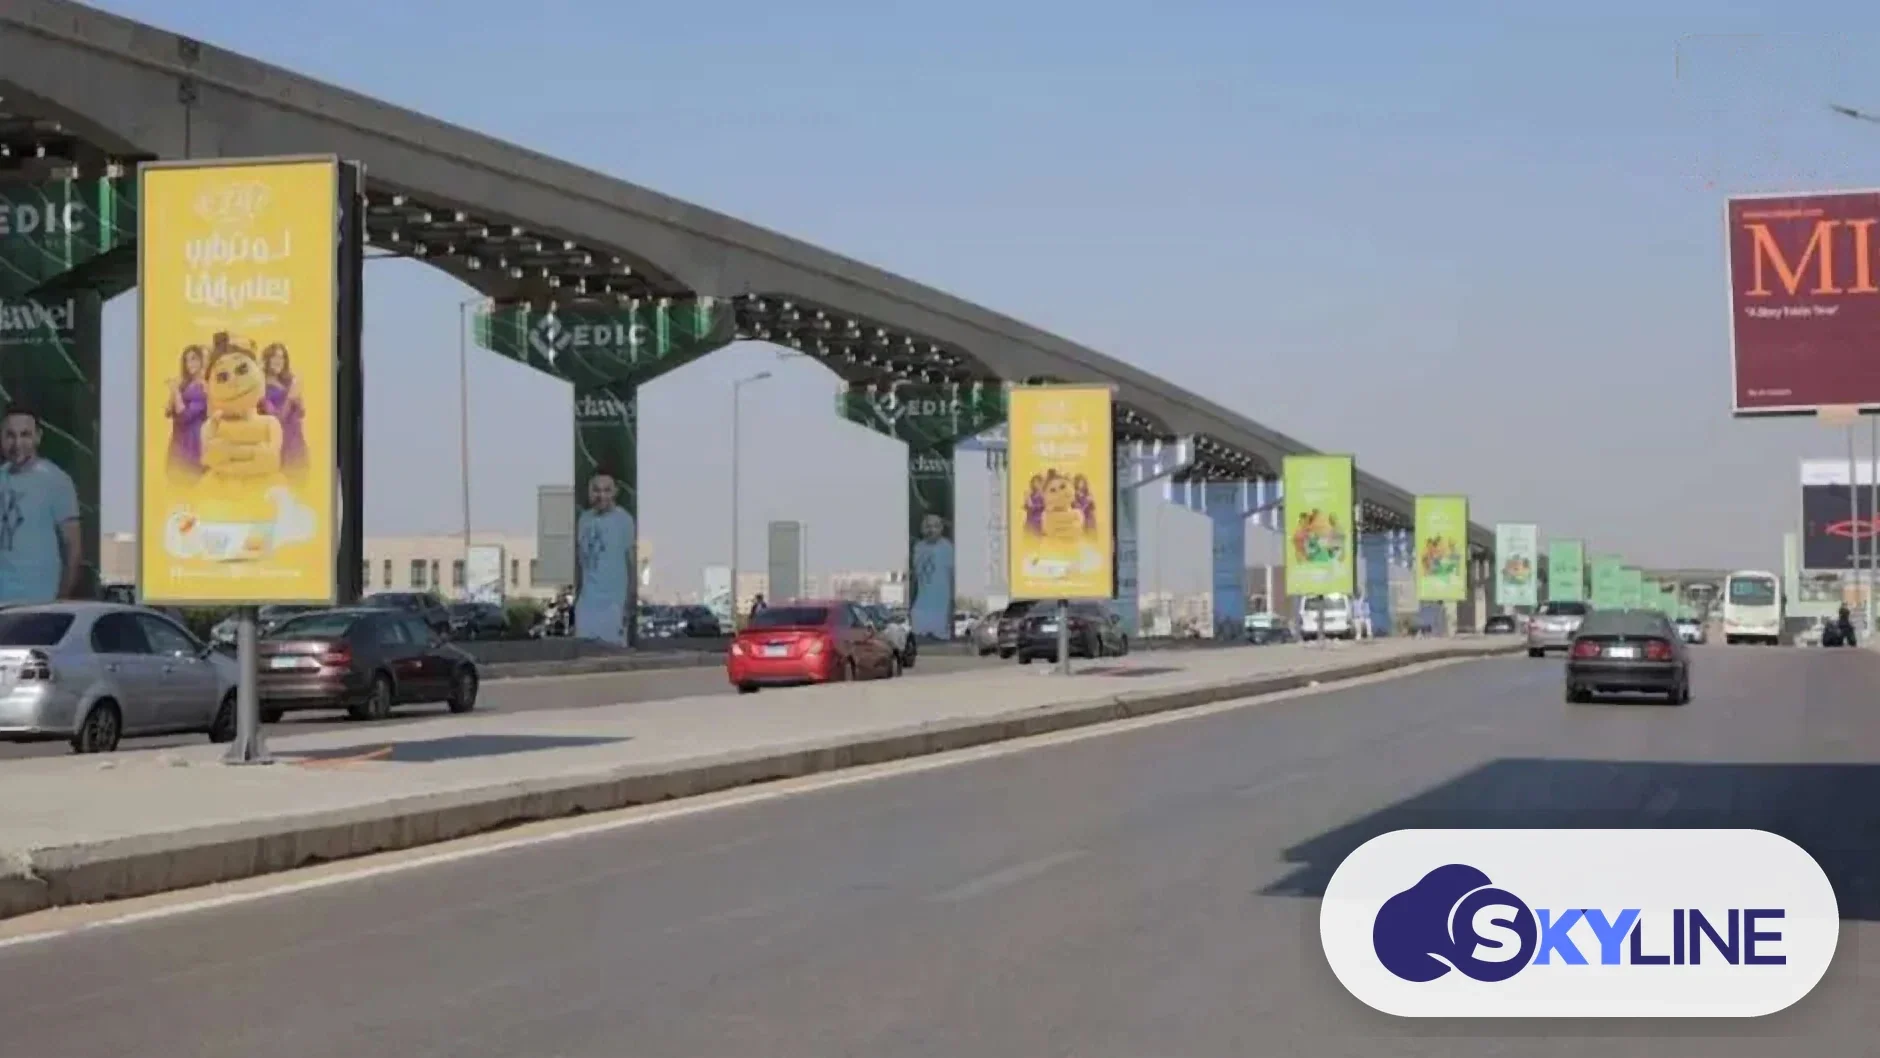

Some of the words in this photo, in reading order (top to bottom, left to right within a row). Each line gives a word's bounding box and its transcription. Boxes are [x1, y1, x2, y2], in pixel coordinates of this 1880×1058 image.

[1743, 218, 1880, 297] MI
[572, 323, 646, 347] EDIC
[907, 399, 961, 416] EDIC
